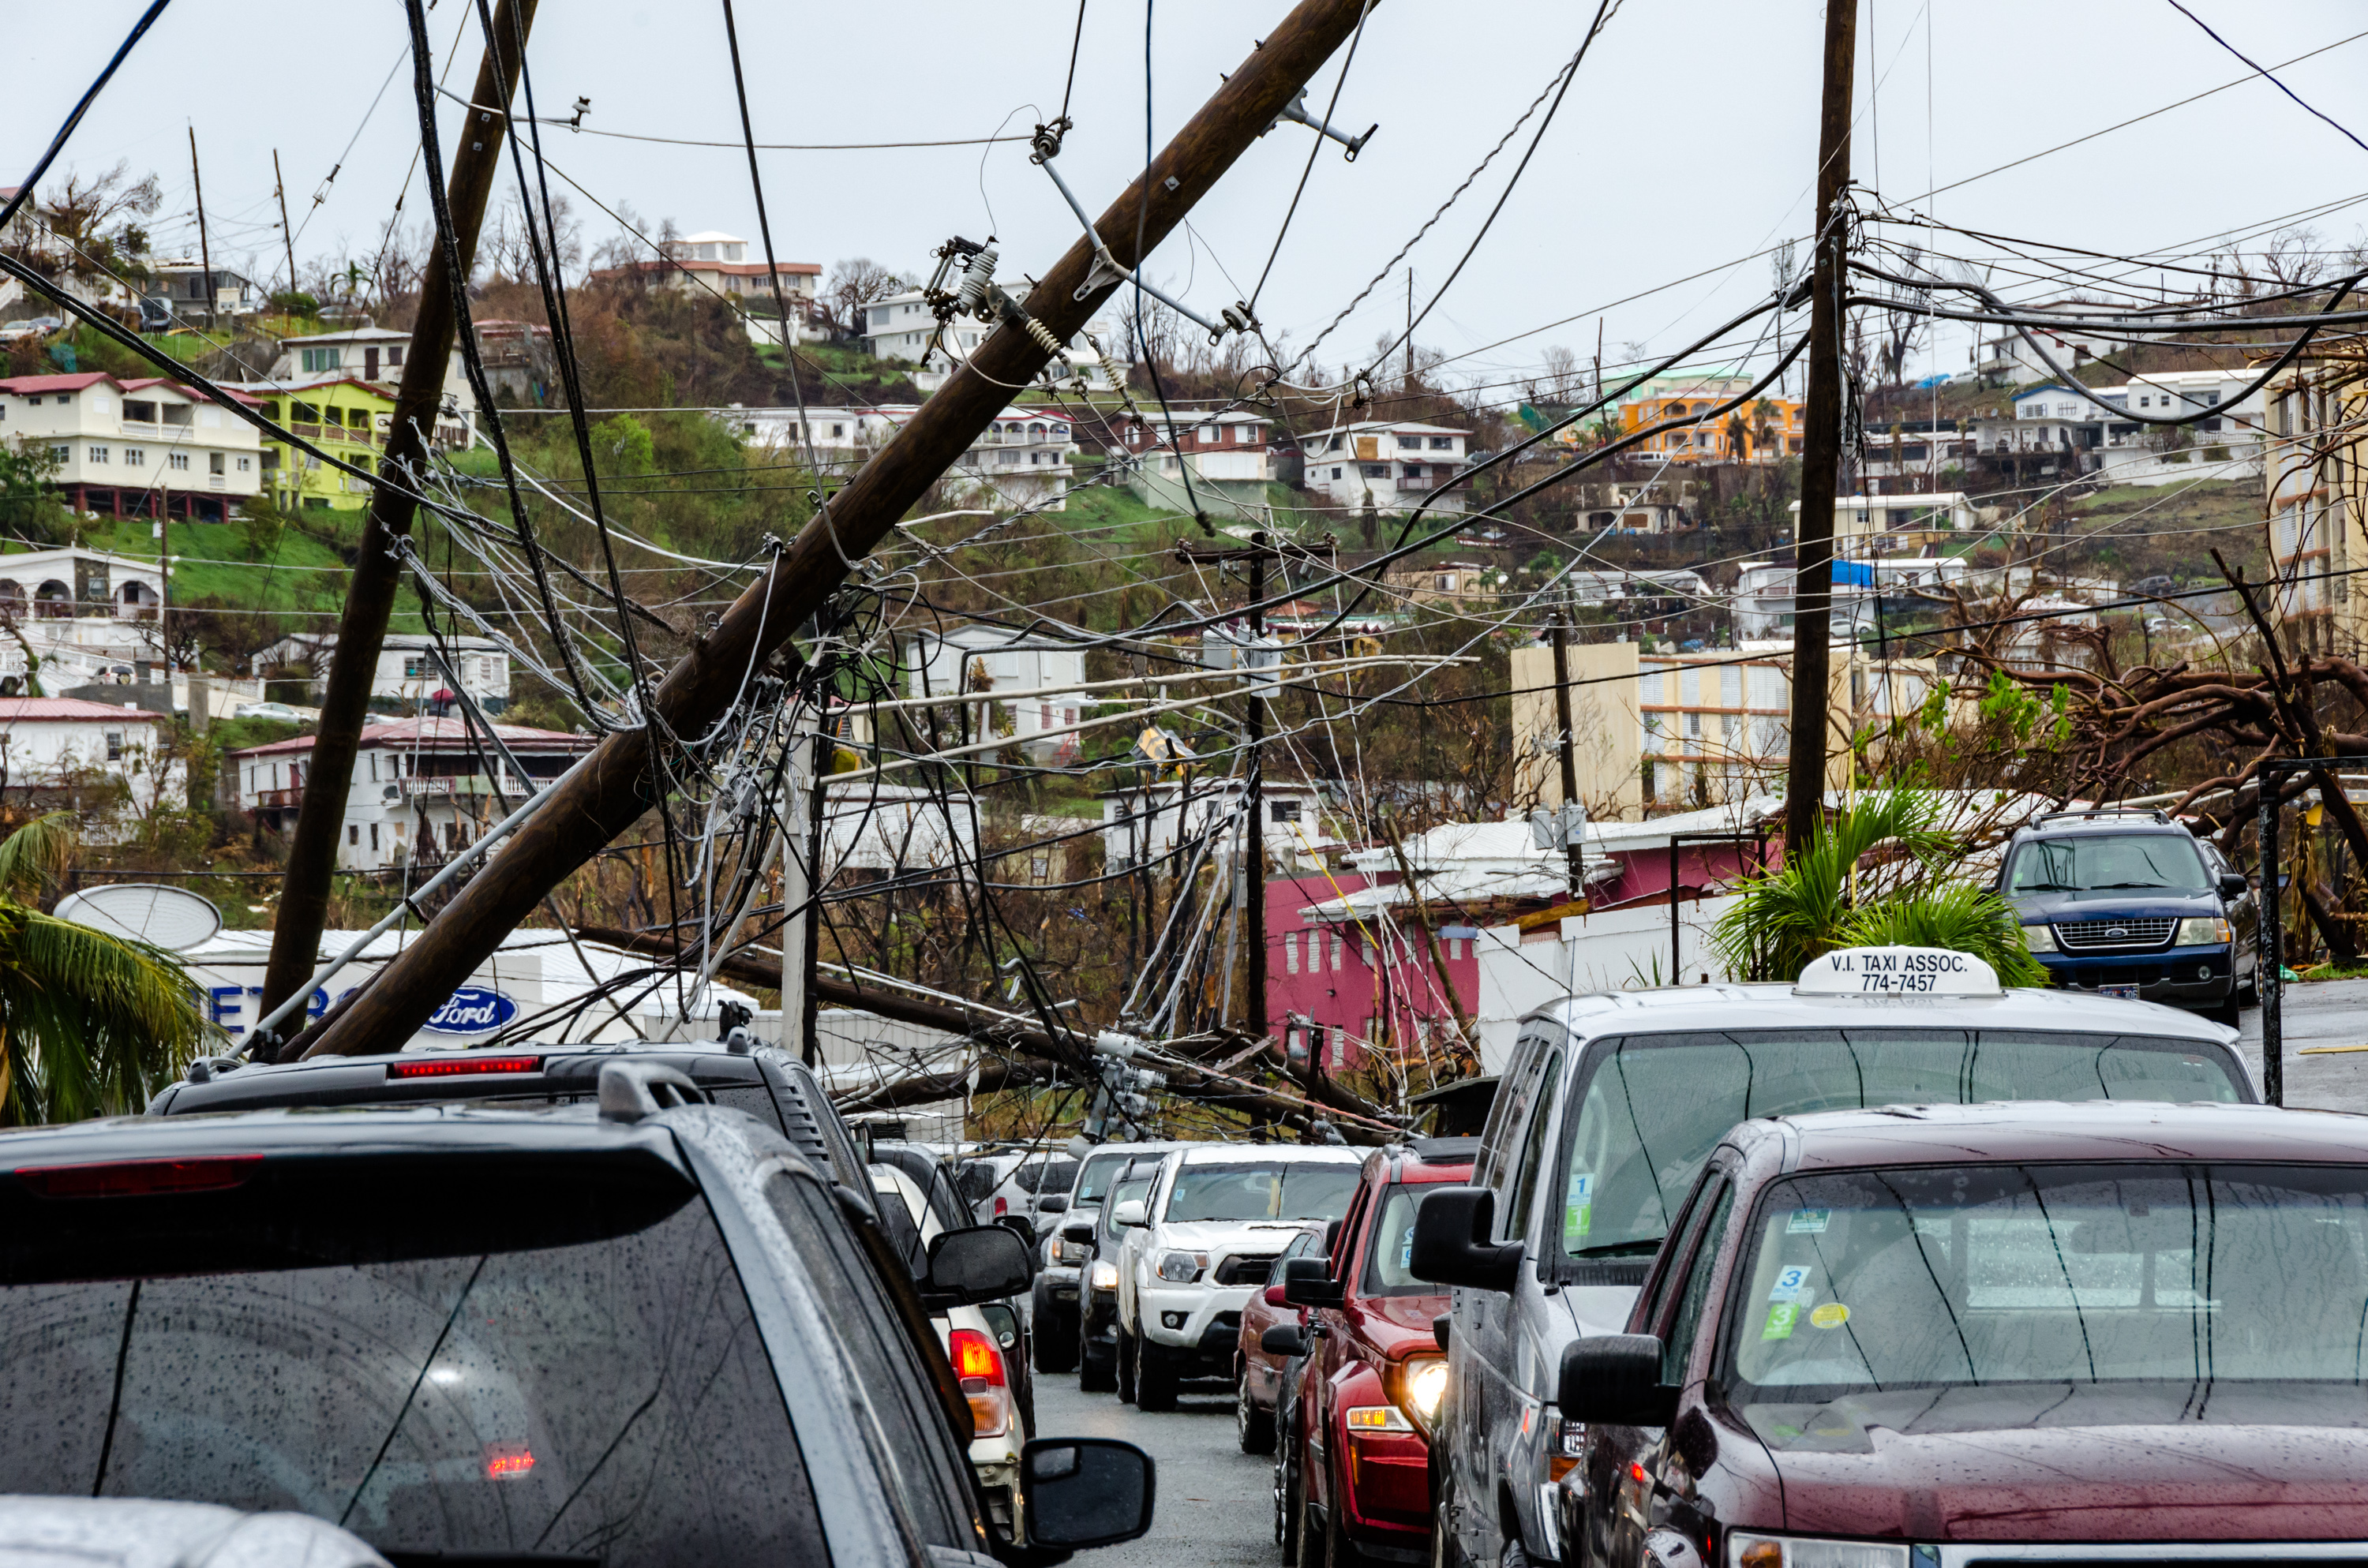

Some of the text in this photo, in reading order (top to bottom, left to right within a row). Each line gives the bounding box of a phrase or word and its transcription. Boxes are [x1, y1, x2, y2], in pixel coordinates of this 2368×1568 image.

[1831, 955, 1968, 972] V.I. TAXI ASSOC.
[1861, 974, 1937, 992] 774-7457
[429, 993, 496, 1024] Ford
[1577, 1177, 1586, 1193] 1
[1573, 1209, 1582, 1225] 1
[1782, 1270, 1801, 1287] 3
[1772, 1308, 1792, 1326] 3
